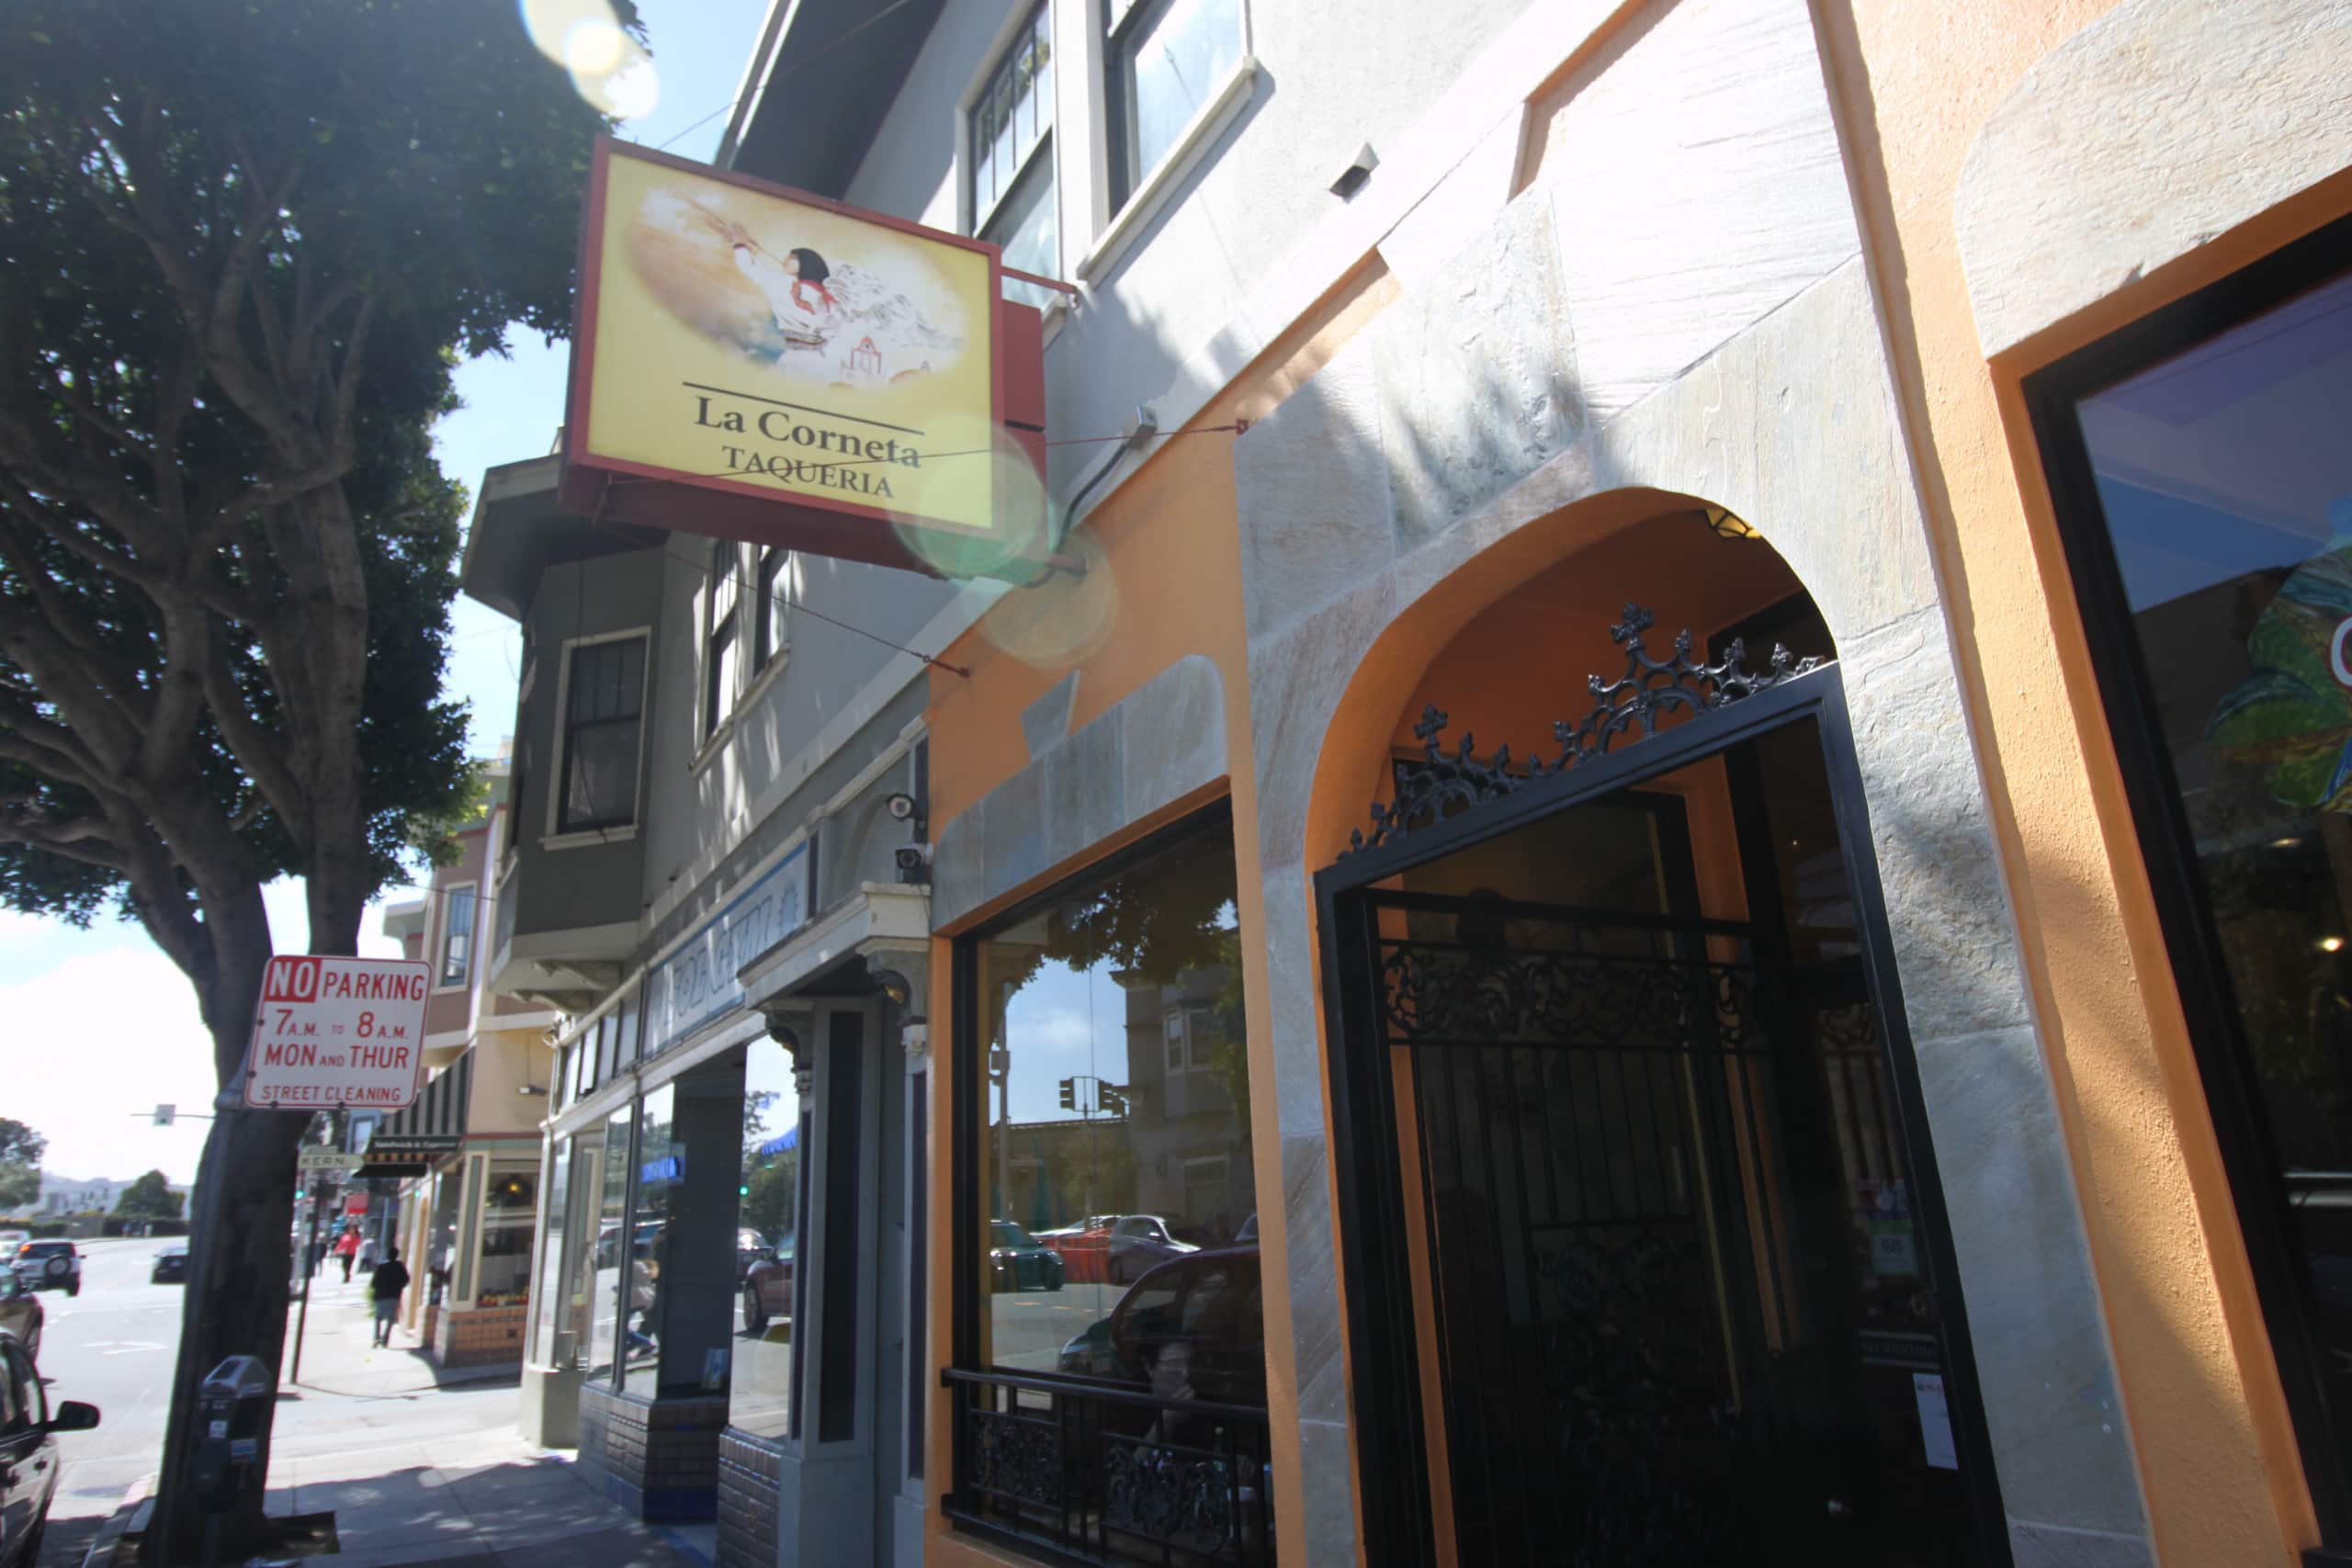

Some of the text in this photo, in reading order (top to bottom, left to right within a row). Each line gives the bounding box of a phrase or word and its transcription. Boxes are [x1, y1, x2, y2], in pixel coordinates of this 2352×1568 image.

[695, 396, 921, 468] La Corneta
[722, 446, 895, 498] TAQUERIA
[268, 961, 424, 1001] NO PARKING
[264, 1043, 410, 1069] MON AND THUR
[261, 1085, 401, 1102] STREET CLEANING
